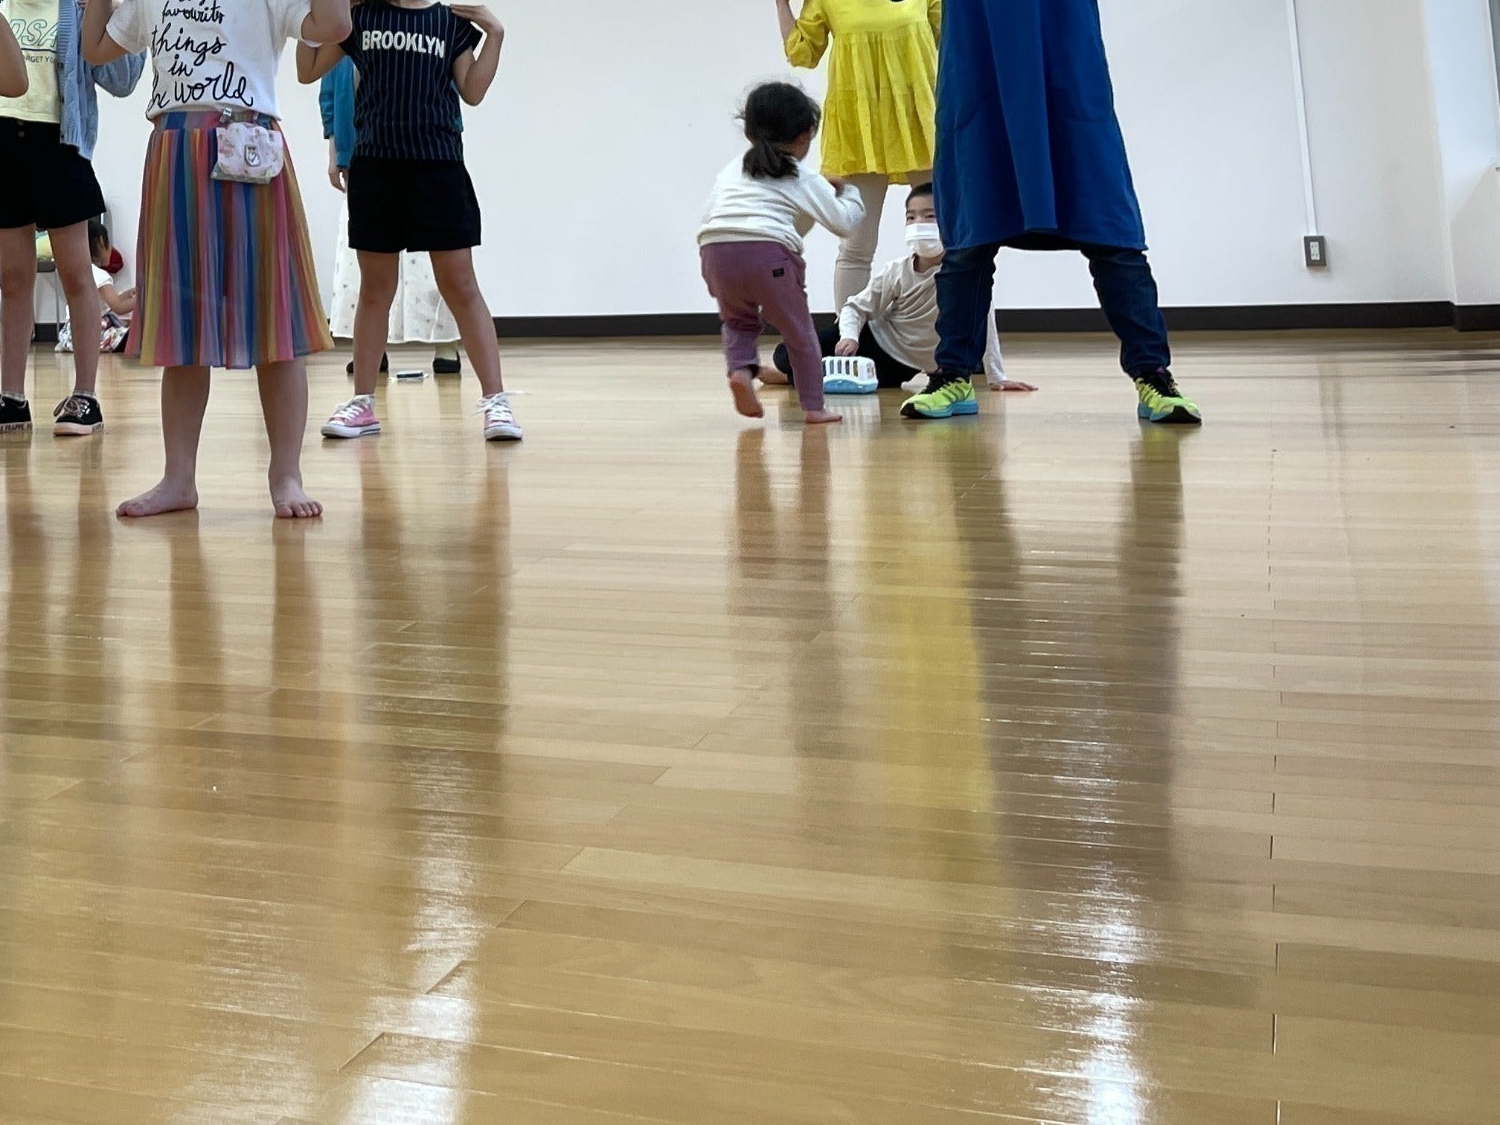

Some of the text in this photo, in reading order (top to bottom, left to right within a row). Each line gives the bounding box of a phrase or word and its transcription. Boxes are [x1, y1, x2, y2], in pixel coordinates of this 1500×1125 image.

[152, 23, 227, 66] things
[361, 30, 445, 59] BROOKLYN
[167, 54, 194, 77] in
[174, 61, 254, 107] world
